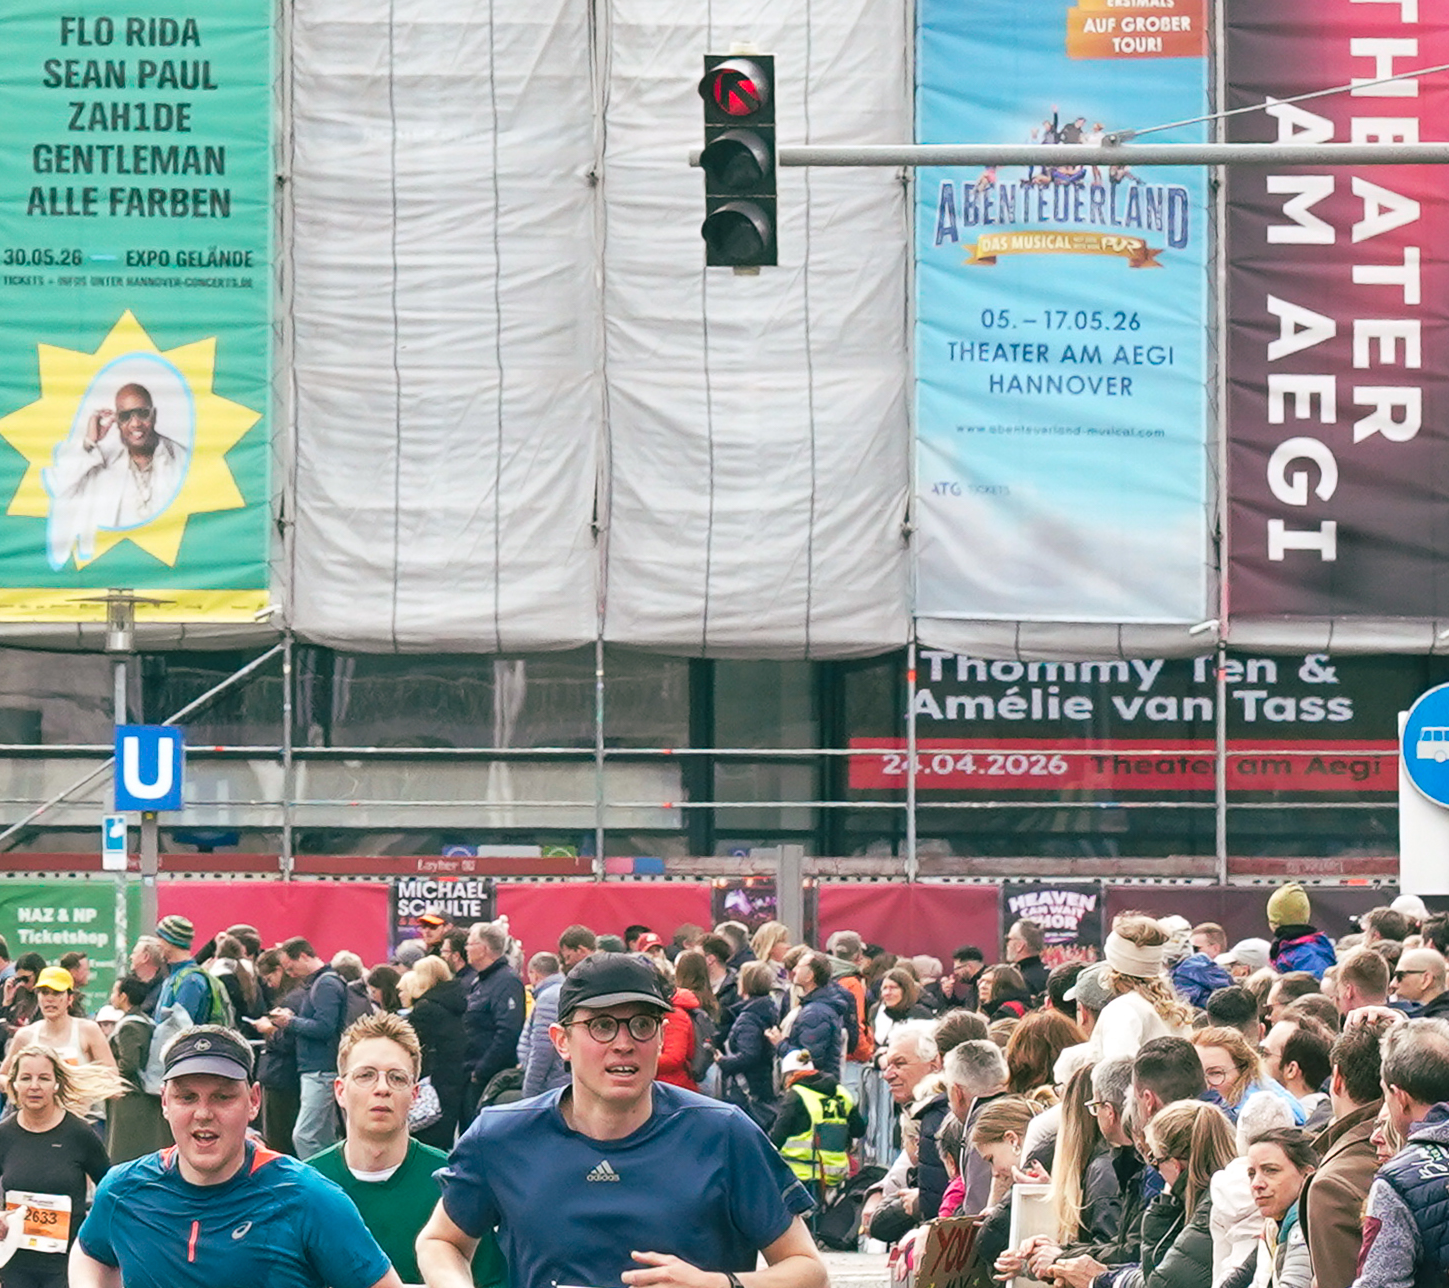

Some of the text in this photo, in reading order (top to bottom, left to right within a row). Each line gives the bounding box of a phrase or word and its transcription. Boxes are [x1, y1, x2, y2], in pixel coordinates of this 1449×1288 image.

[60, 16, 201, 47] FLO RIDA
[1083, 18, 1116, 33] AUF
[1112, 37, 1162, 52] TOUR!
[43, 59, 219, 90] SEAN PAUL
[68, 102, 192, 132] ZAH1DE
[32, 144, 226, 176] GENTLEMAN
[26, 187, 231, 219] ALLE FARBEN
[981, 238, 1008, 253] DAS
[1011, 235, 1072, 252] MUSICAL
[3, 248, 83, 267] 30.05.26
[126, 245, 254, 268] EXPO GELÄNDE
[981, 310, 1141, 331] 05. 17.05.26
[1265, 95, 1339, 561] AM AEGI
[949, 342, 1174, 366] THEATER AM AEGI
[990, 375, 1133, 397] HANNOVER
[921, 652, 1166, 691] Thommy
[1299, 655, 1340, 684] &
[911, 687, 1355, 723] Amélie van Tass
[123, 736, 174, 800] U
[883, 754, 1381, 782] 24.04.2026 am Aegi
[398, 880, 488, 899] MICHAEL
[397, 899, 481, 917] SCHULTE
[1008, 891, 1097, 914] HEAVEN
[17, 907, 97, 923] HAZ & NP
[17, 929, 109, 948] Ticketshop
[586, 1171, 620, 1183] adidas
